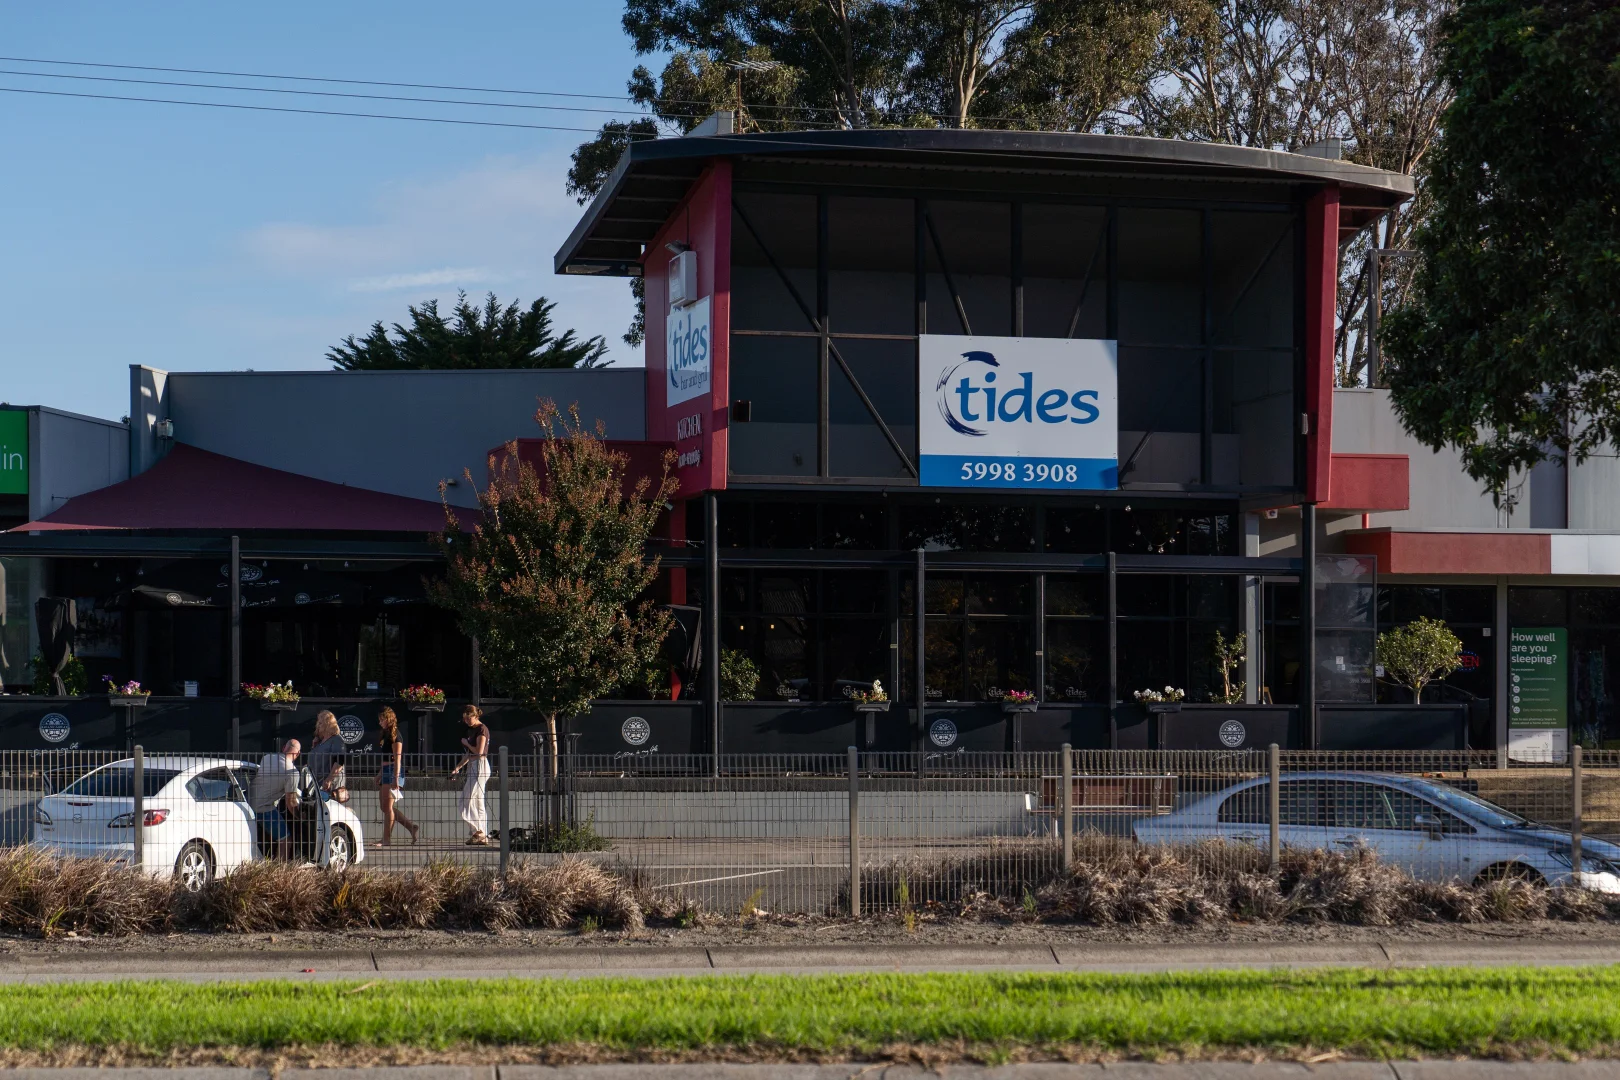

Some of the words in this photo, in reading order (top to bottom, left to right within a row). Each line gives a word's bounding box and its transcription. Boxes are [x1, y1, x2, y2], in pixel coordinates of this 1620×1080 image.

[672, 312, 708, 371] tides
[955, 371, 1100, 424] tides
[961, 462, 1016, 481] 5998
[1023, 463, 1077, 483] 3908
[1511, 632, 1533, 642] How
[1535, 632, 1556, 642] well
[1529, 645, 1548, 654] you
[1511, 653, 1557, 665] sleeping?
